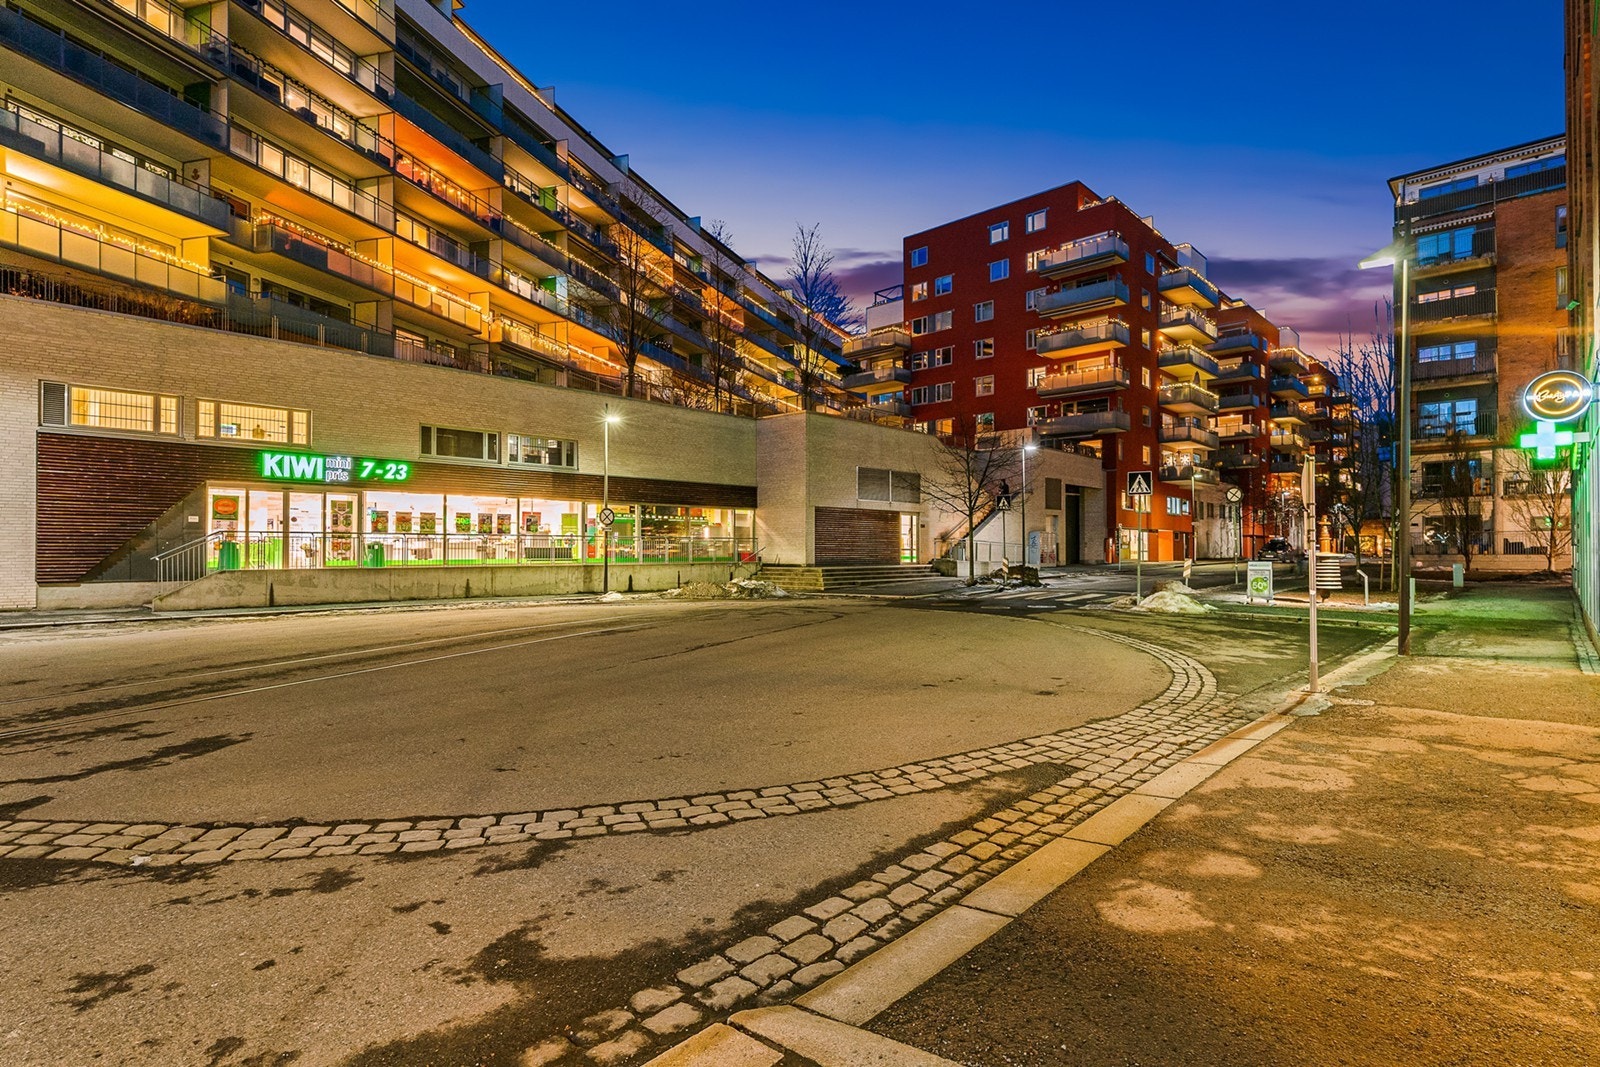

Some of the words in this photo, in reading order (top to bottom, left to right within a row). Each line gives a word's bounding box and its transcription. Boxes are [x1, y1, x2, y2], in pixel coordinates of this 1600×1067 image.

[262, 453, 324, 480] KIWI
[325, 457, 352, 469] mini
[360, 461, 409, 480] 7-23
[325, 469, 349, 482] pris
